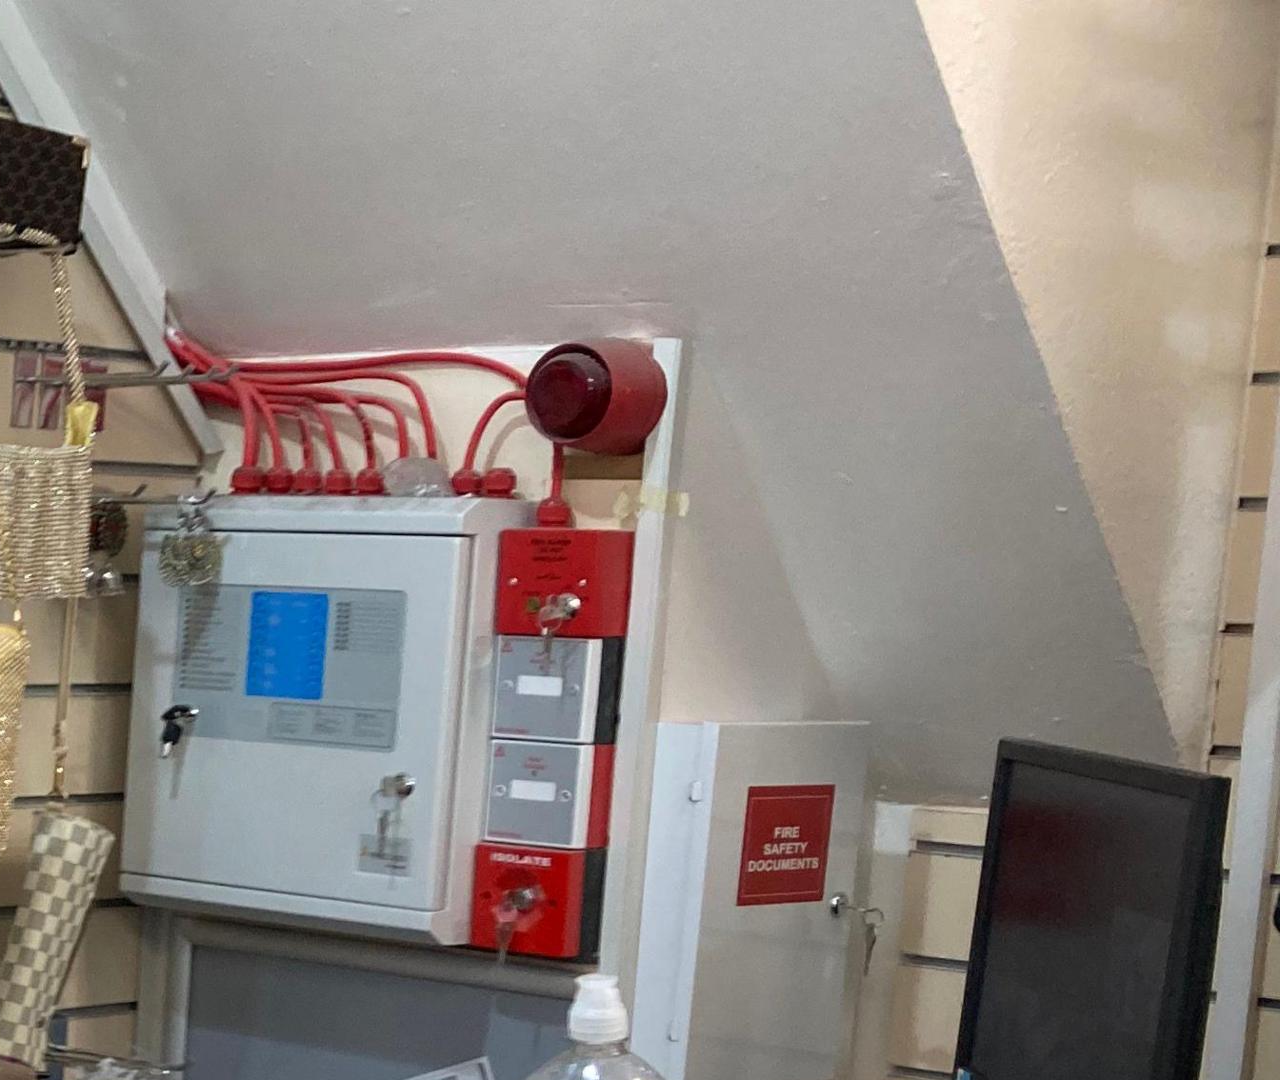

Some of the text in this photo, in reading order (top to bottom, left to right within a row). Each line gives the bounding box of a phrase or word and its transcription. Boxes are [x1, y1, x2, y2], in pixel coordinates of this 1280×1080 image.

[773, 826, 800, 839] FIRE
[763, 842, 808, 856] SAFETY
[490, 852, 552, 867] ISOLATE
[747, 857, 819, 872] DOCUMENTS
